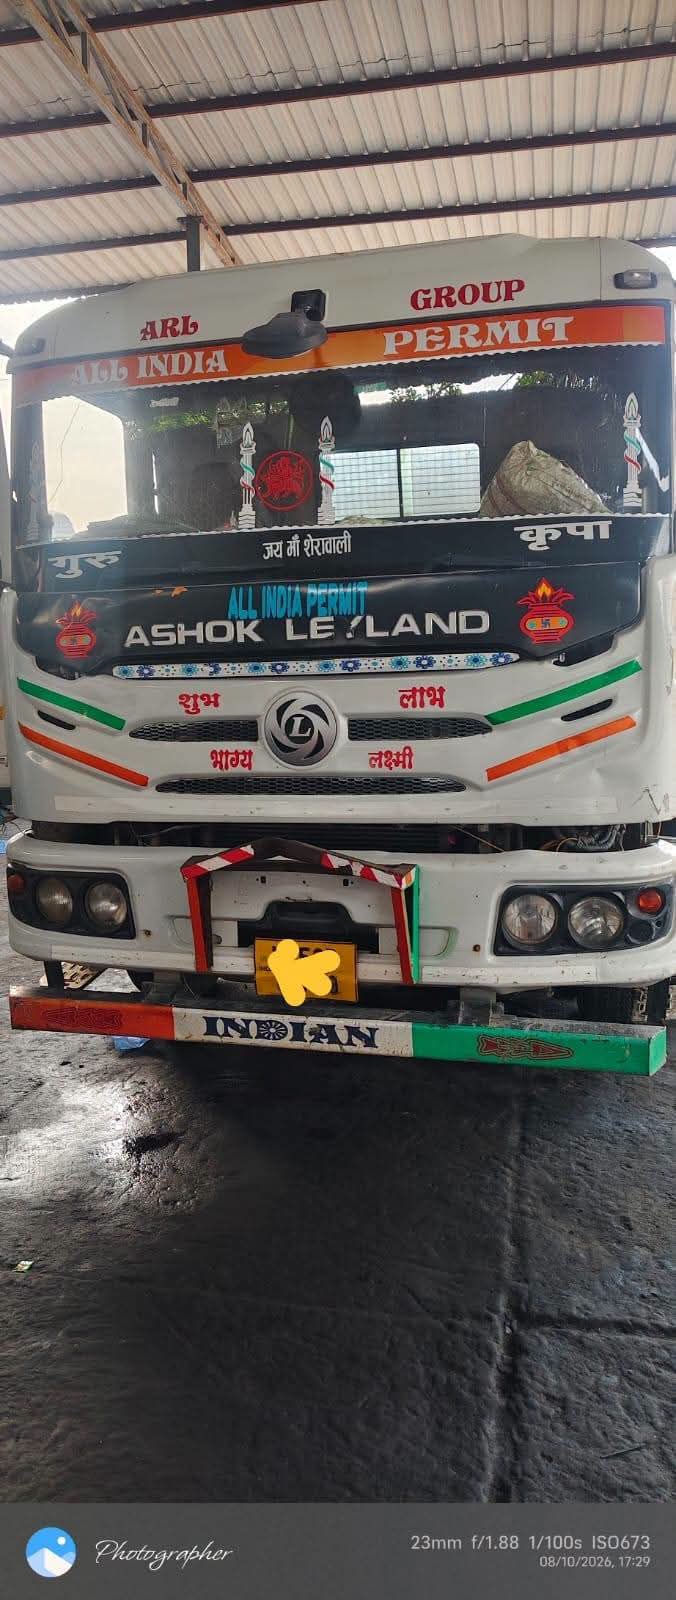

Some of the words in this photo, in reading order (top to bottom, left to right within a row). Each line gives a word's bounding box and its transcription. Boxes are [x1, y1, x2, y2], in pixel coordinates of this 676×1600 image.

[140, 315, 199, 342] ARL
[410, 279, 525, 311] GROUP
[71, 359, 129, 386] ALL
[136, 350, 229, 379] INDIA
[383, 316, 574, 356] PERMIT
[262, 541, 284, 560] जय
[286, 533, 301, 557] माँ
[303, 530, 352, 557] शेरावाली
[514, 520, 613, 551] कृपा
[227, 585, 258, 620] ALL
[262, 584, 303, 619] INDIA
[306, 581, 368, 617] PERMIT
[124, 618, 265, 648] ASHOK
[178, 692, 221, 715] शुभ
[398, 686, 447, 709] लाभ
[289, 716, 311, 737] L
[210, 749, 254, 771] भाग्य
[367, 745, 414, 771] लक्ष्मी
[202, 1015, 379, 1048] INDIAN
